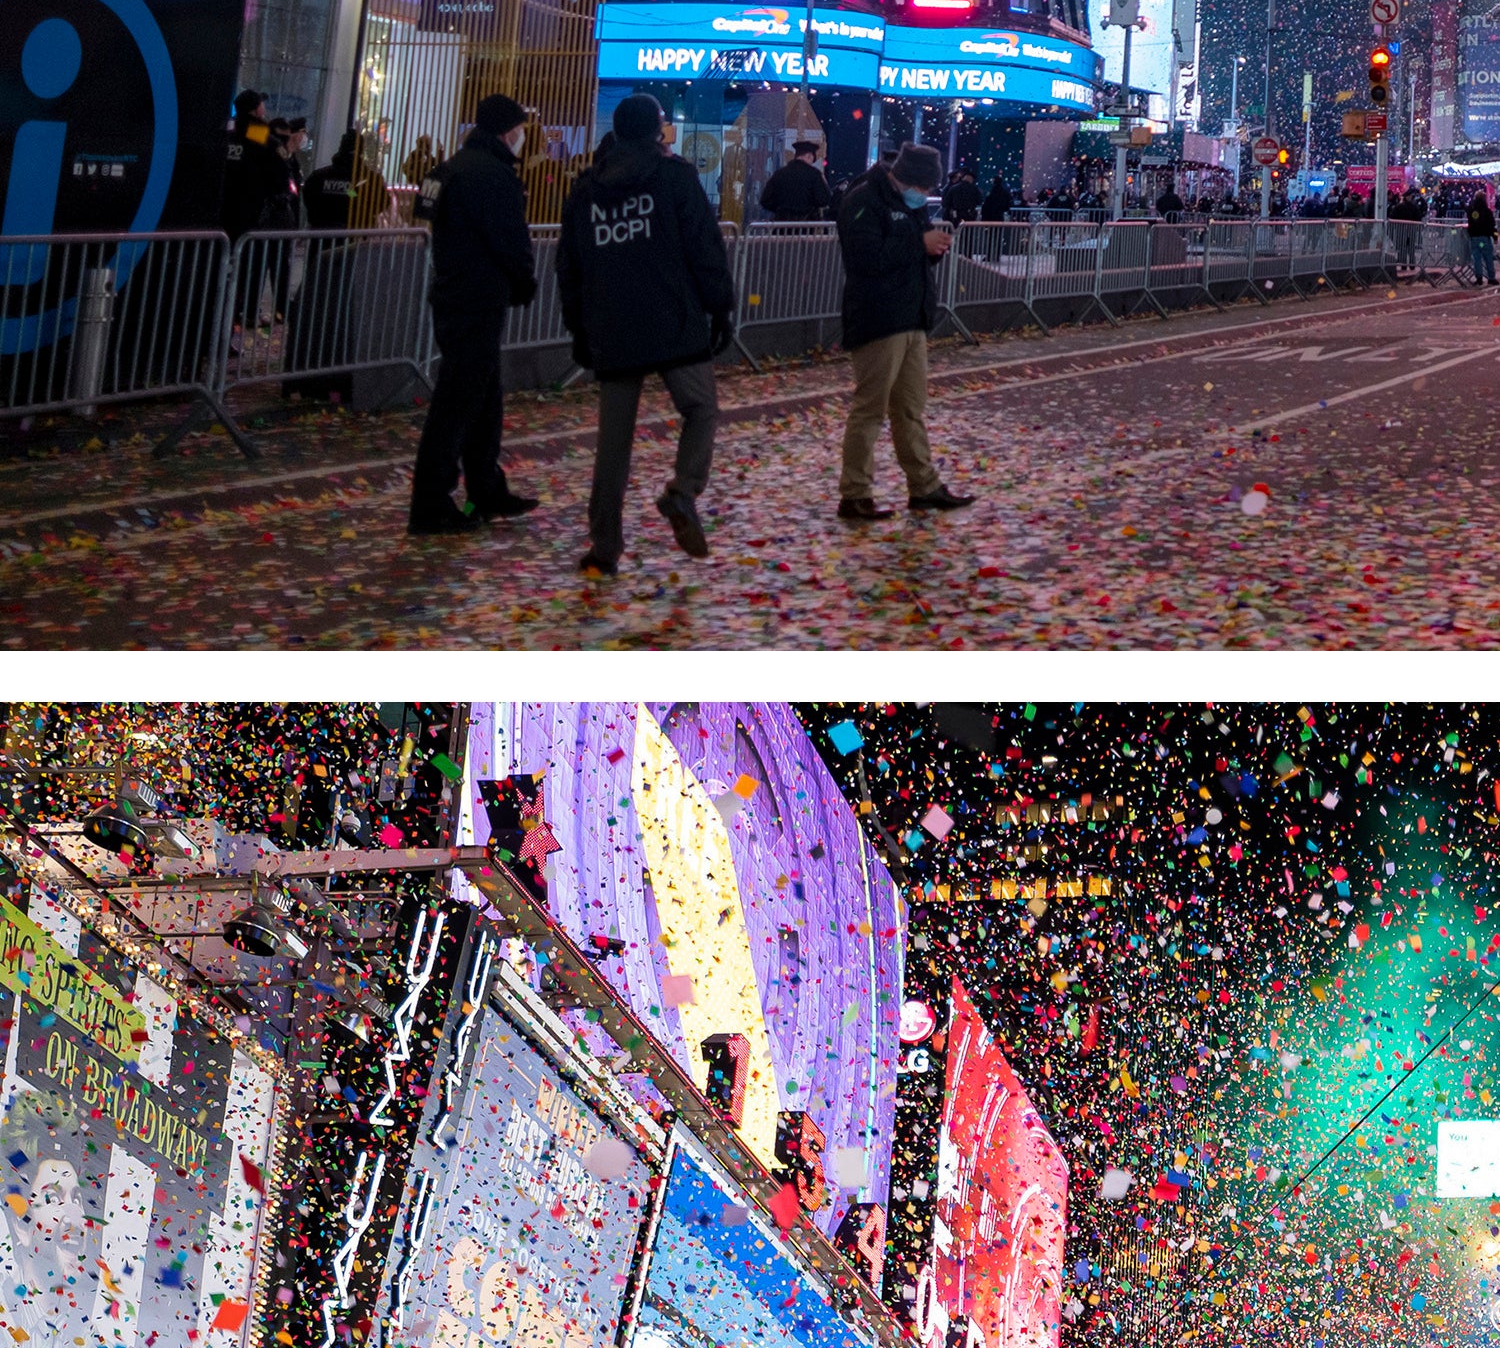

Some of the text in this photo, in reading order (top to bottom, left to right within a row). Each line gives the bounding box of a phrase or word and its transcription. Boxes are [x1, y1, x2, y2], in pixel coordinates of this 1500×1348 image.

[637, 48, 829, 77] HAPPY NEW YEAR
[901, 66, 950, 91] NEW
[953, 68, 1006, 93] YEAR
[322, 179, 353, 194] NYPD
[593, 216, 652, 247] DCPI
[45, 1030, 79, 1092] ON
